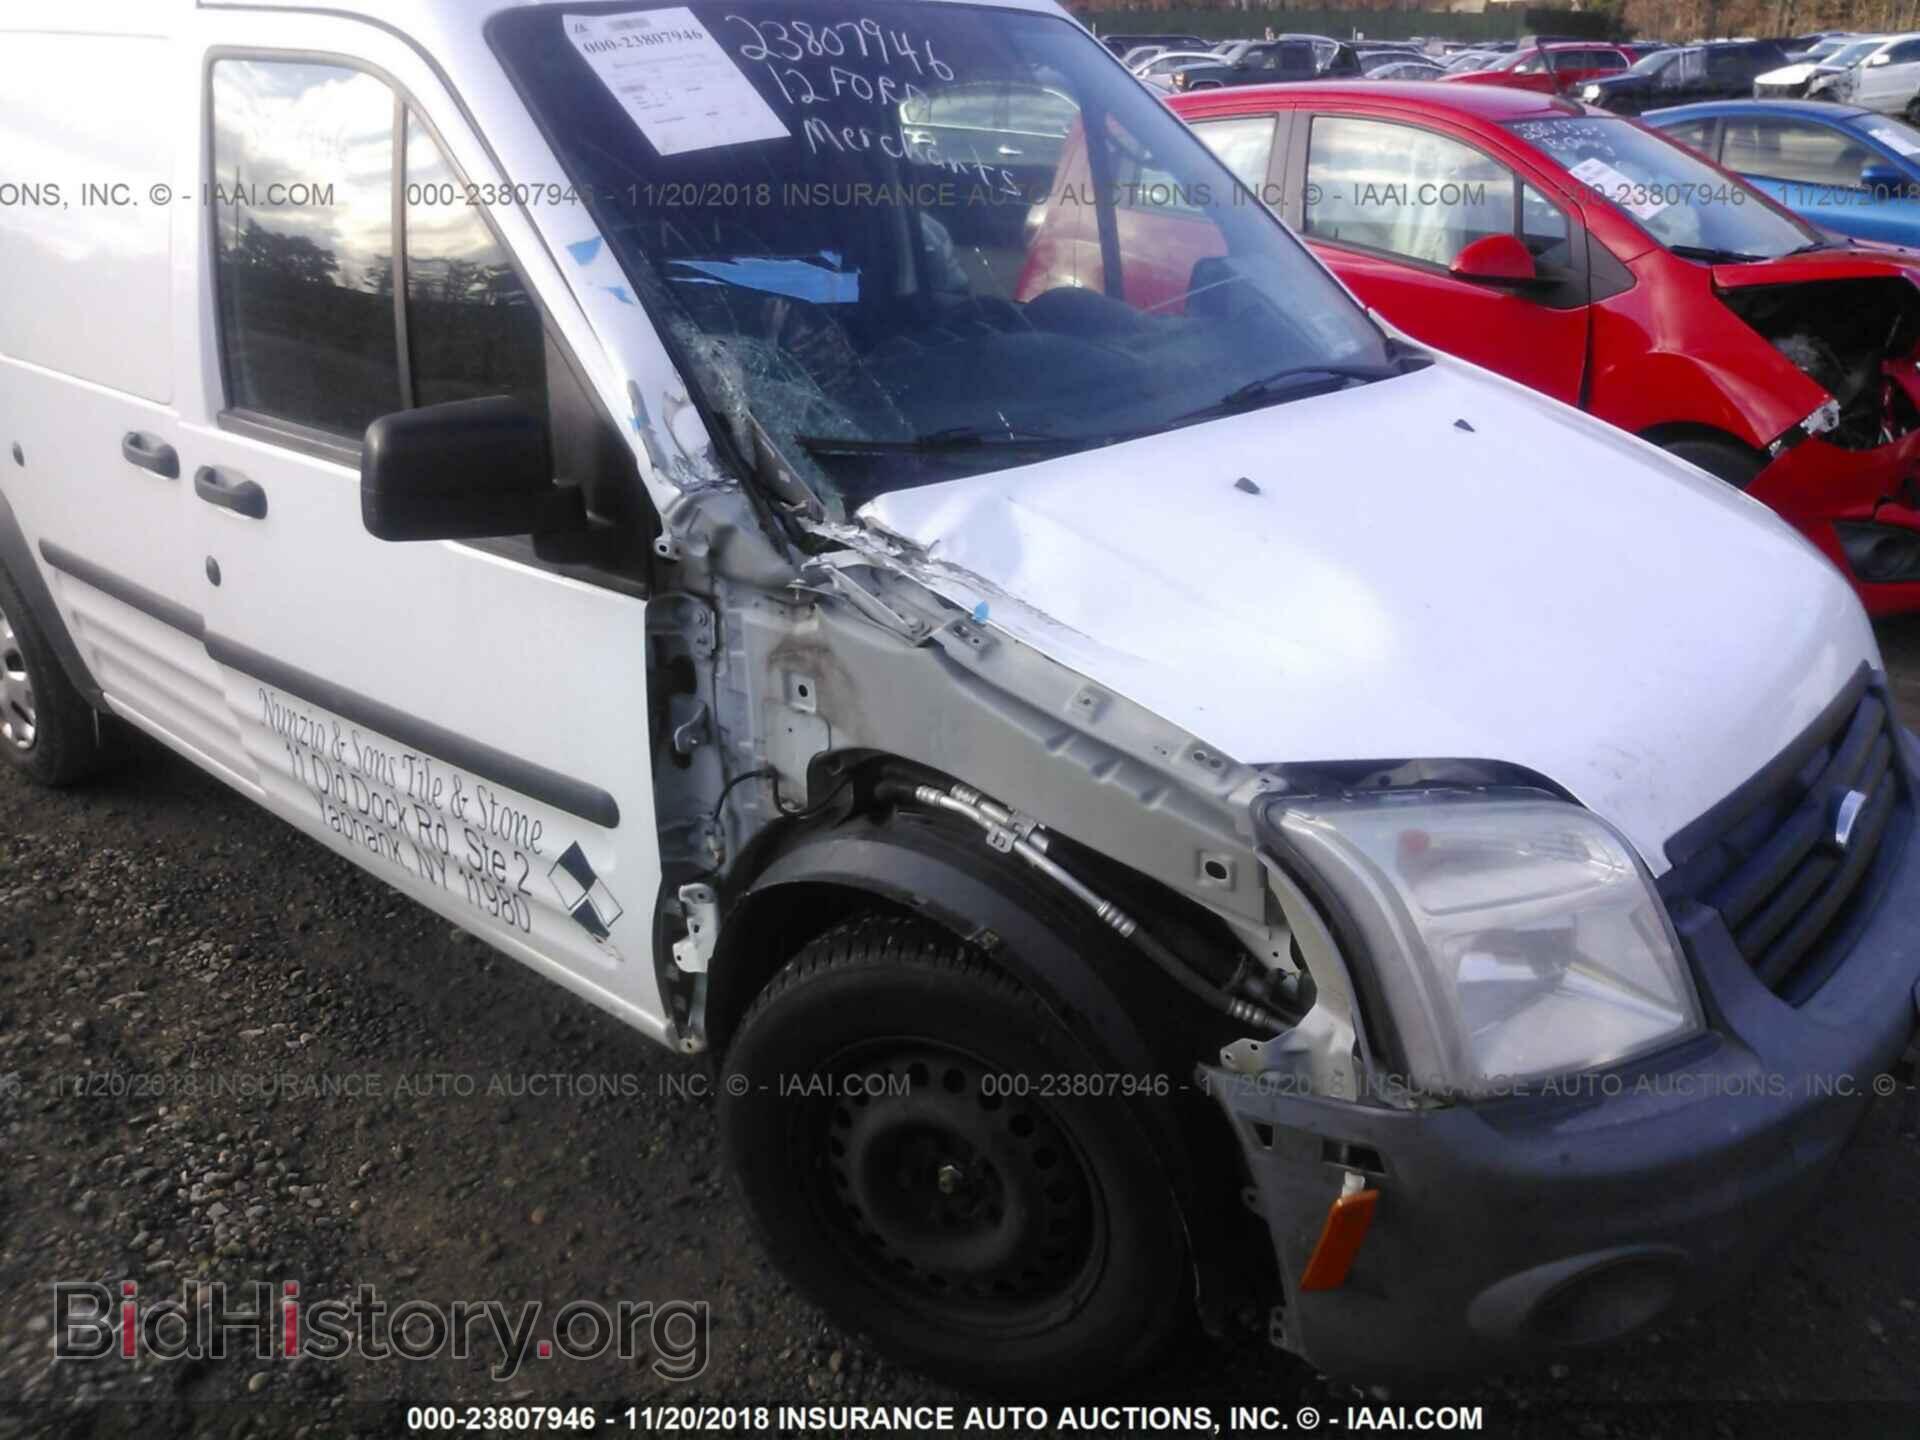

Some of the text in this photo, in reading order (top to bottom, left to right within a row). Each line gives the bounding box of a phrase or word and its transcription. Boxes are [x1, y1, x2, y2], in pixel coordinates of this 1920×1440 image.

[583, 28, 704, 54] 000-23807946
[724, 17, 955, 82] 23807946
[767, 62, 930, 106] 12 FORD
[803, 117, 1022, 197] Merchants
[352, 729, 396, 788] Sons
[402, 754, 442, 810] Tile
[450, 773, 469, 822] &
[476, 785, 543, 855] Stone
[351, 773, 411, 839] Dock
[464, 828, 507, 884] Ste
[513, 851, 533, 896] 2
[459, 865, 532, 934] 11980
